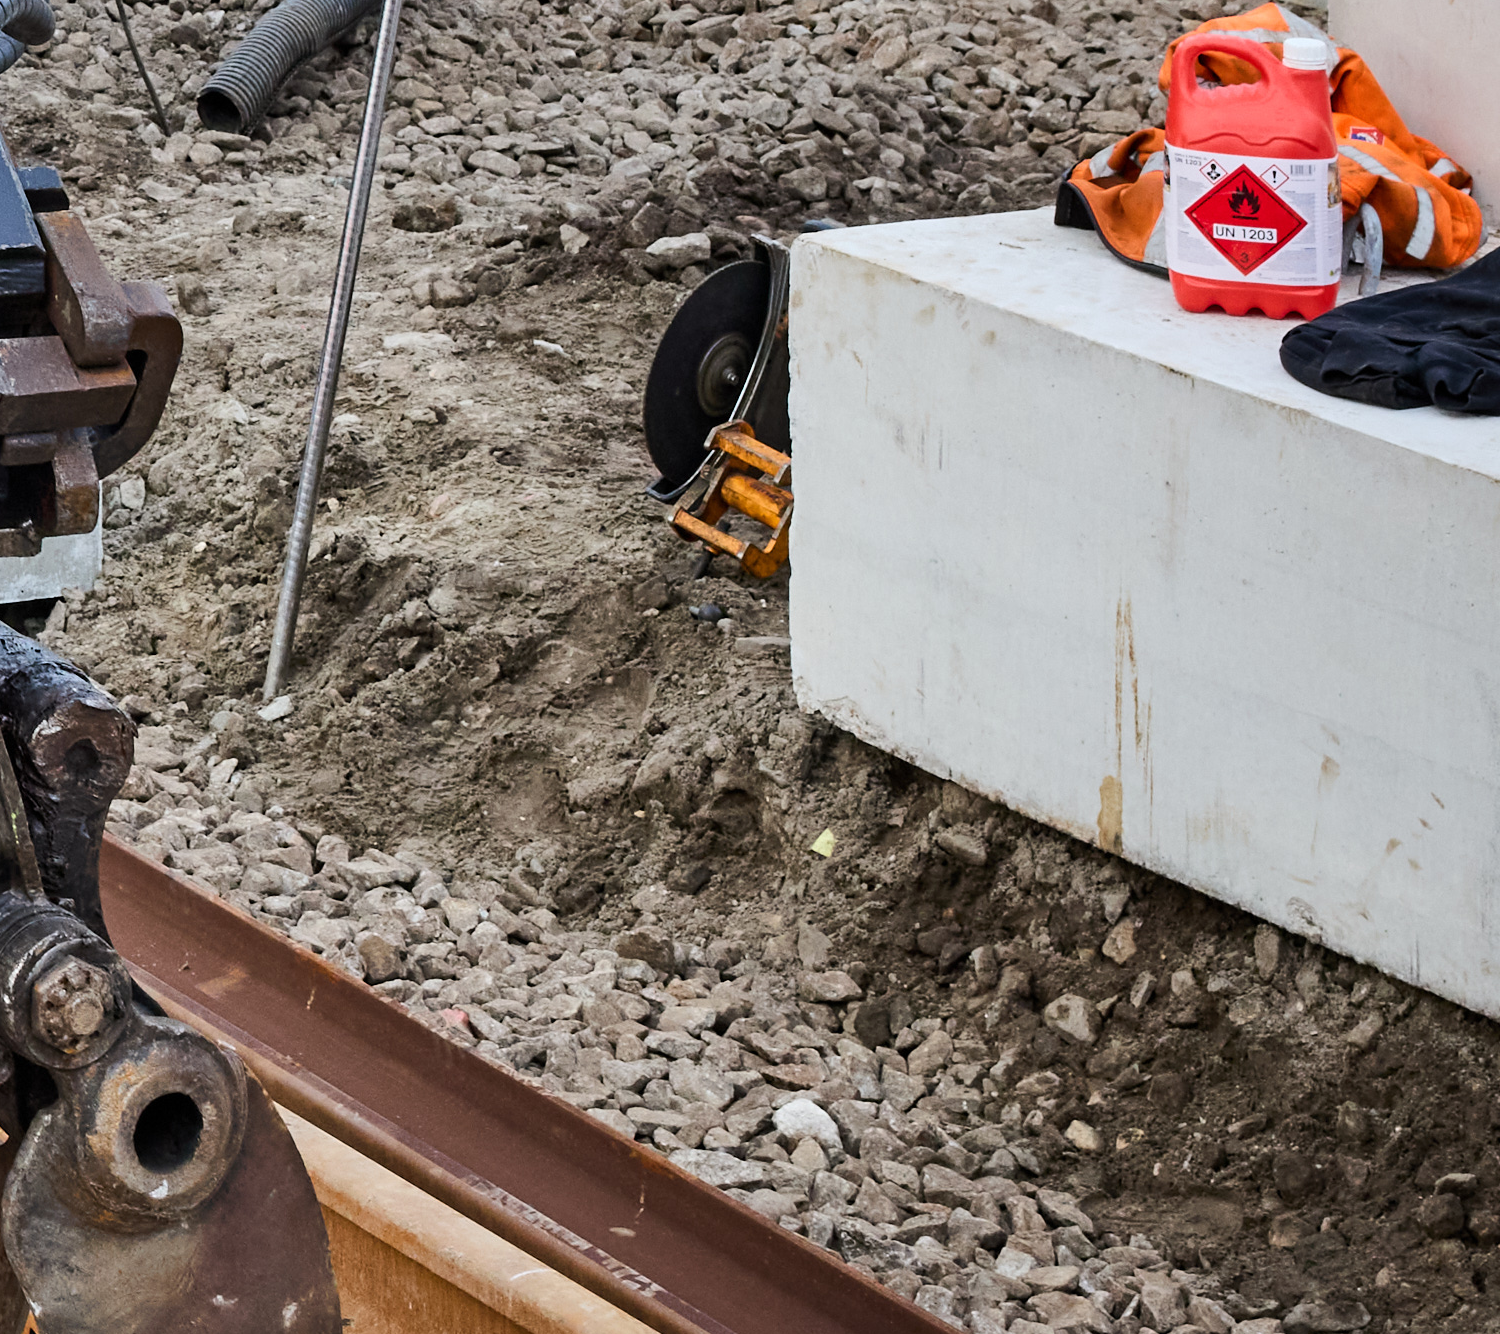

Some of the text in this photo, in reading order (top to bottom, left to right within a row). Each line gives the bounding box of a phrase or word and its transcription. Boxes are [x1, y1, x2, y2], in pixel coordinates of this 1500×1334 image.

[1215, 225, 1275, 241] UN 1203
[1240, 252, 1250, 264] 3
